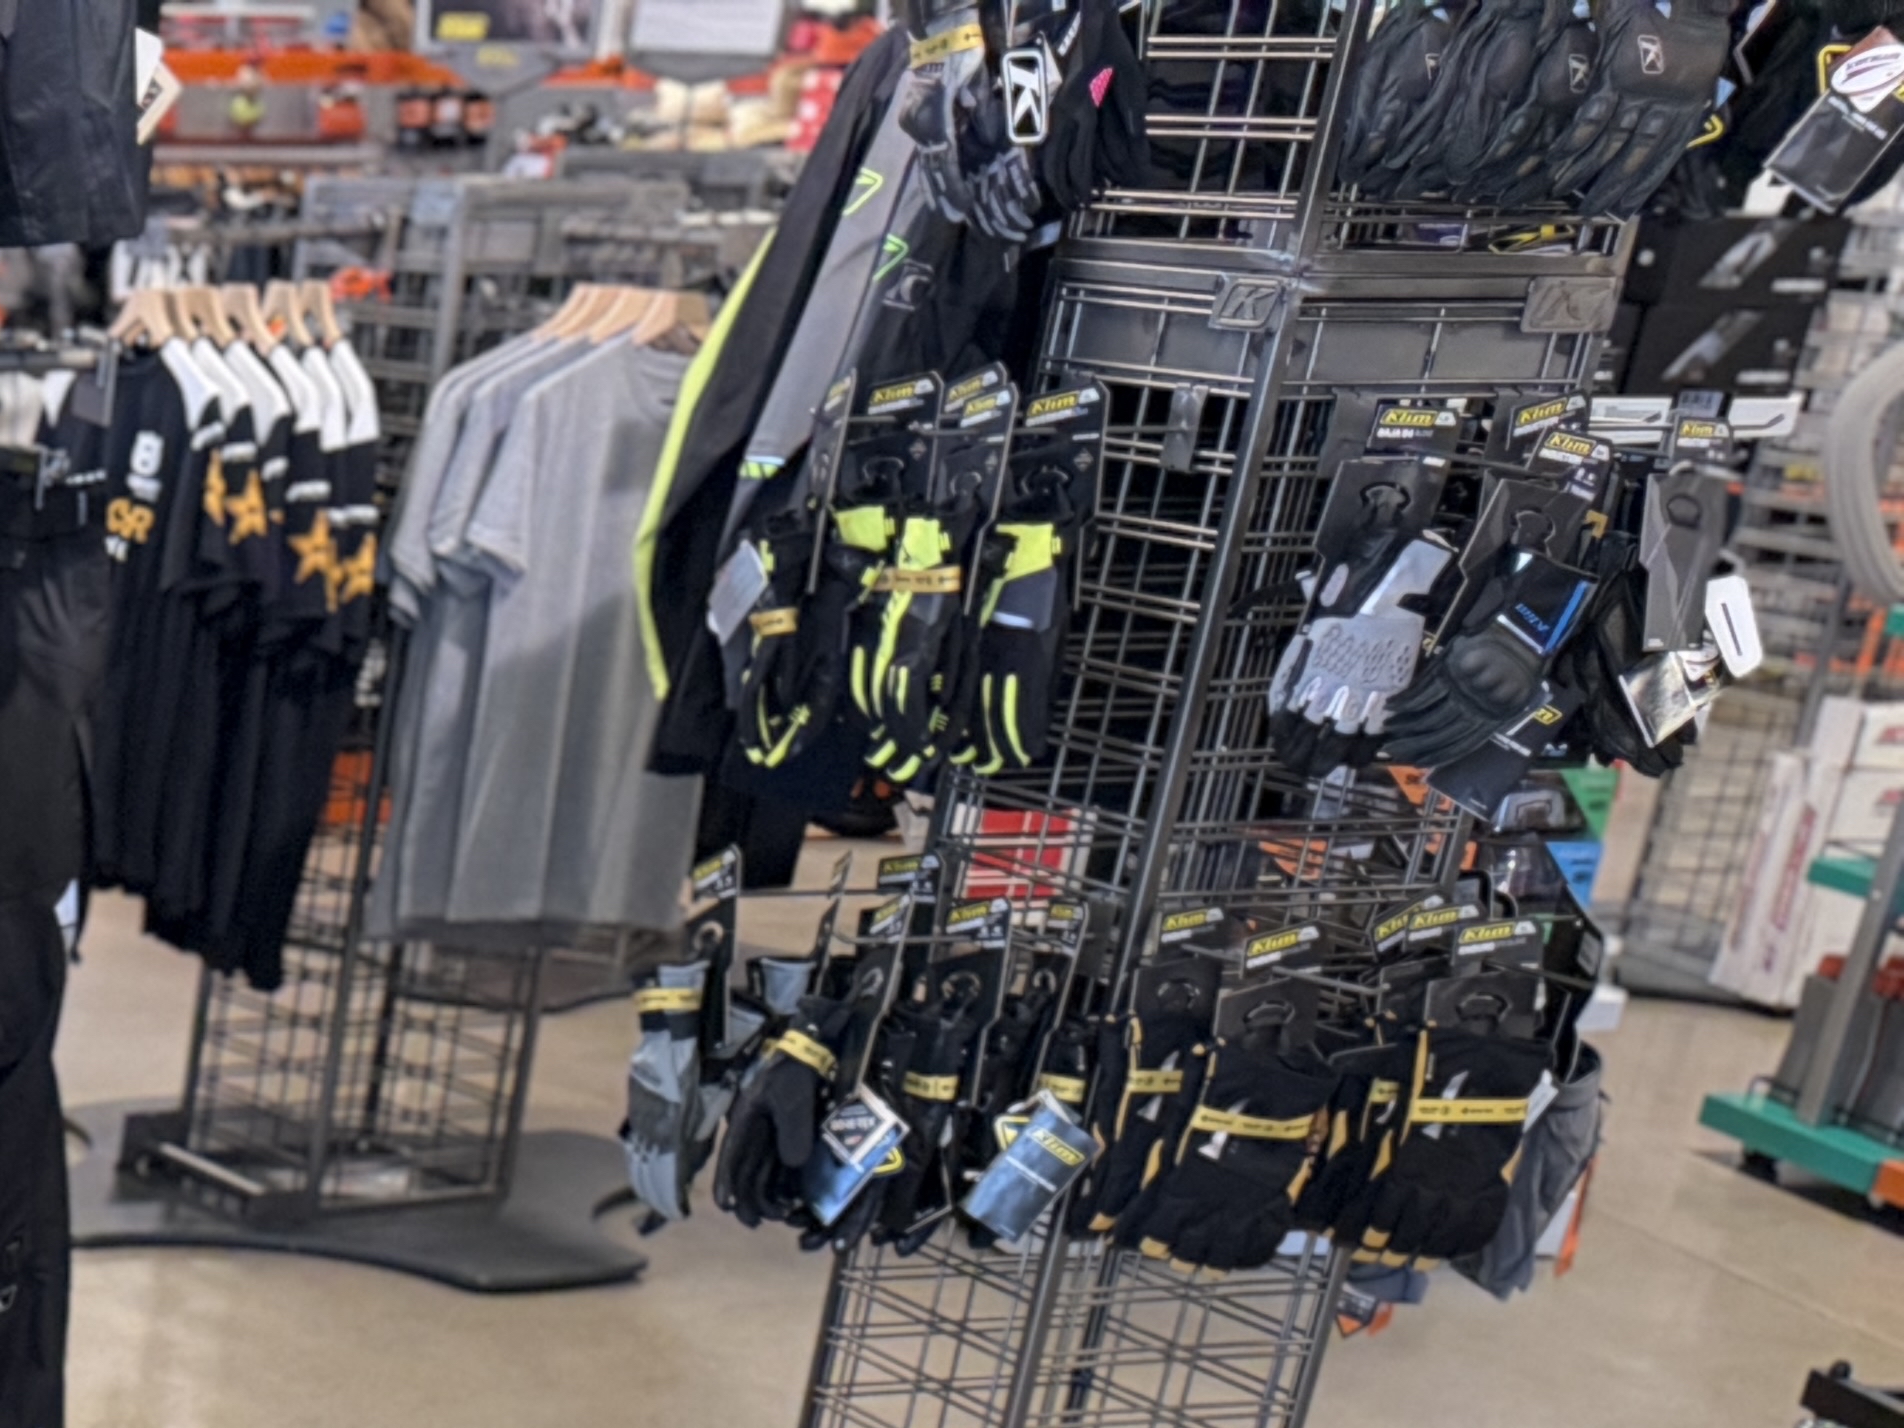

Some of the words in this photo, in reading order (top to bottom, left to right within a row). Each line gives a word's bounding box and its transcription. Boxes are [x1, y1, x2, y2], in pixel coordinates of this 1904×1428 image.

[1384, 410, 1432, 425] Klim
[1518, 402, 1565, 424] Klim
[1548, 434, 1593, 456] Klim
[1464, 924, 1511, 942] Klim
